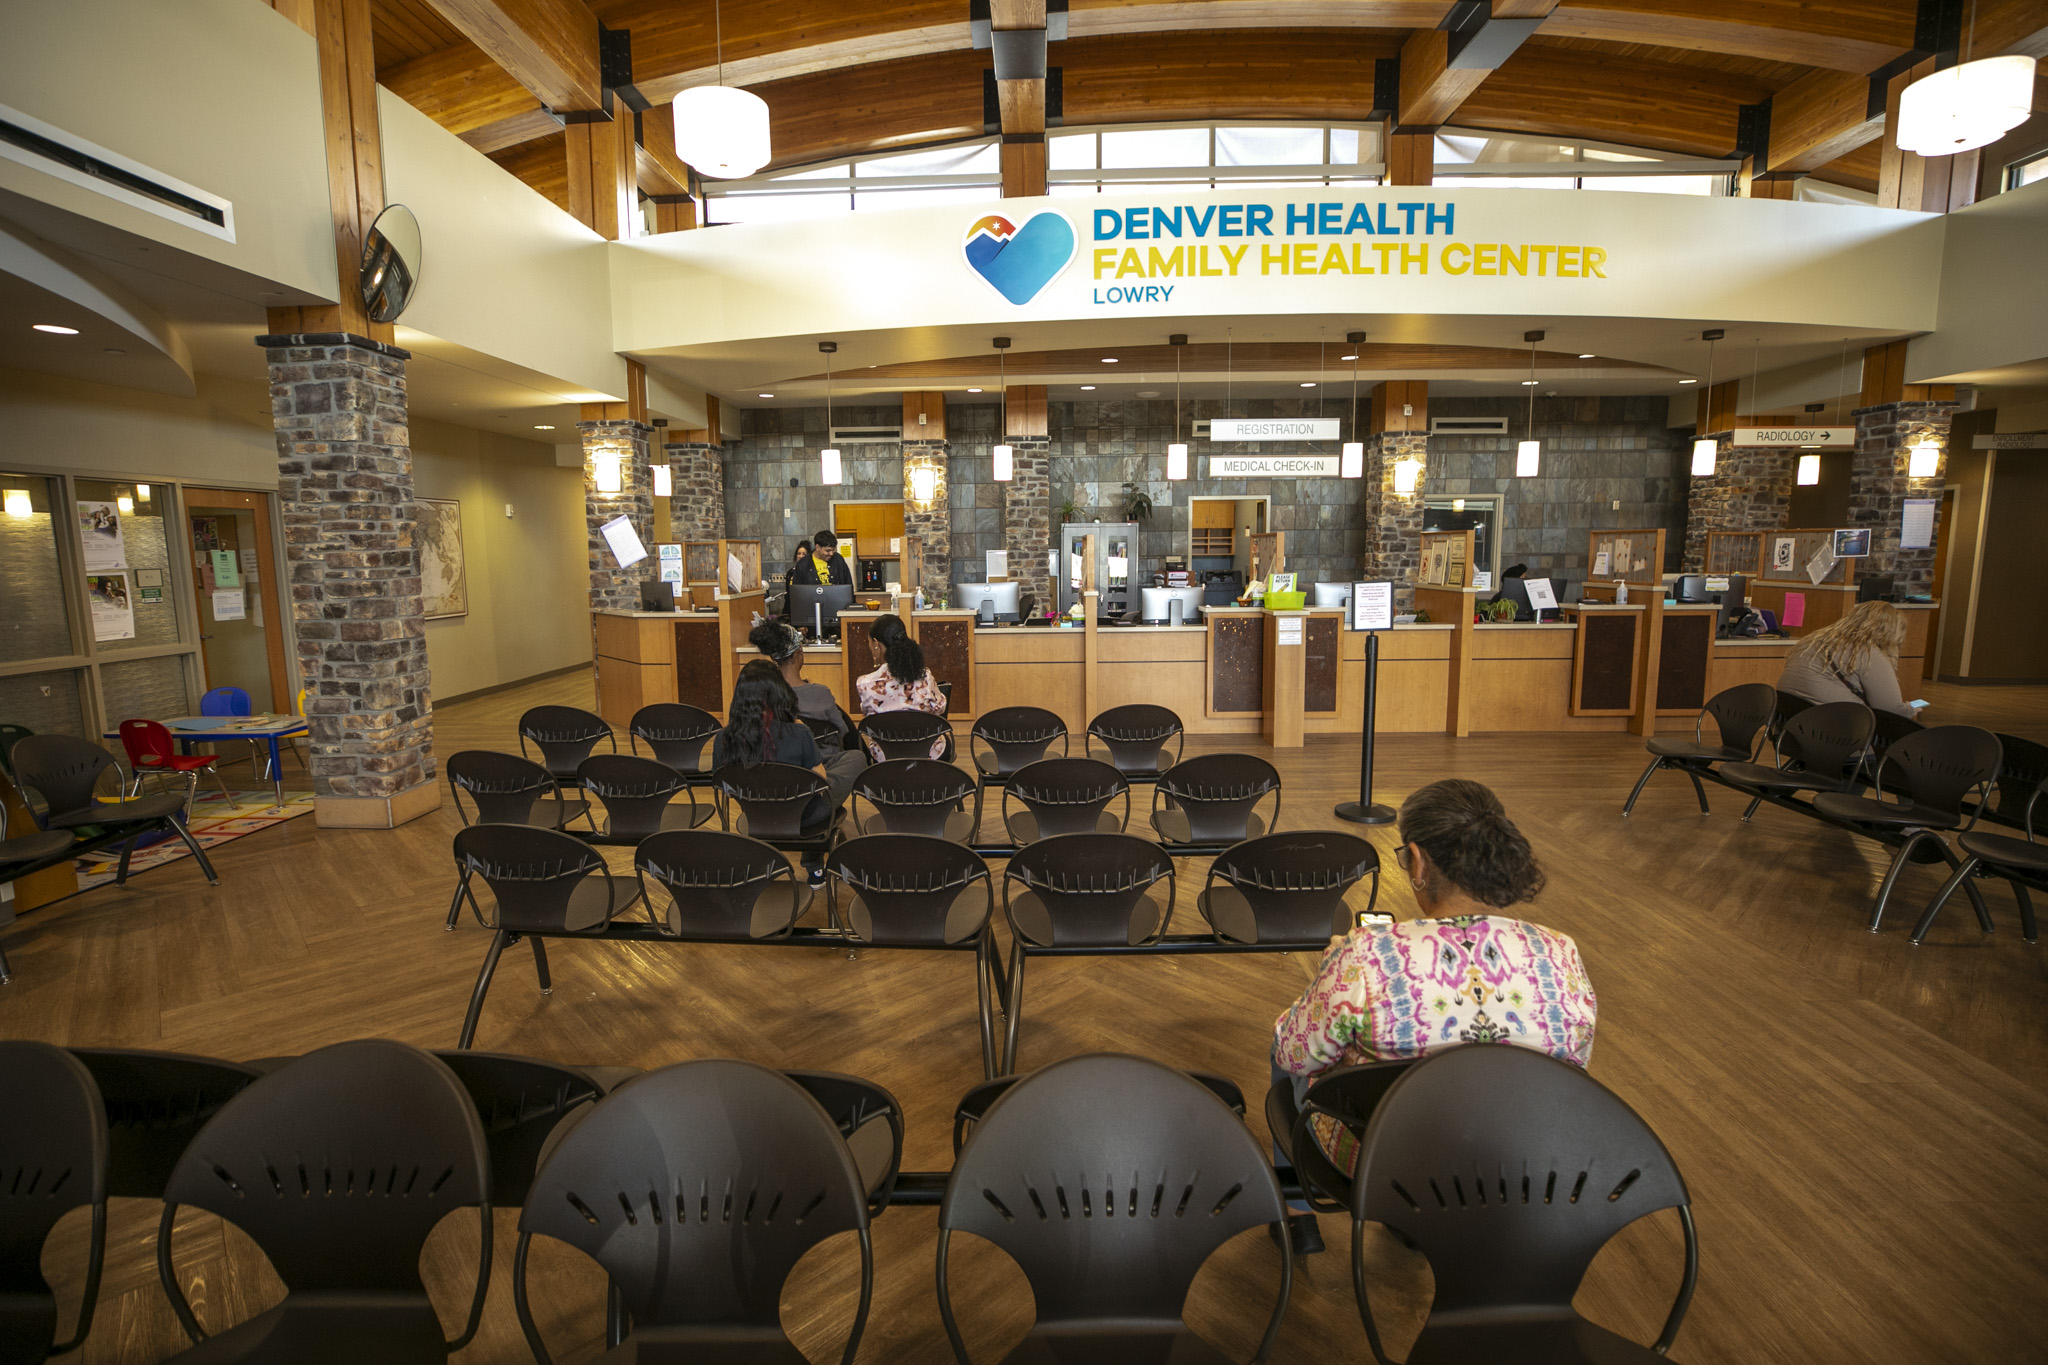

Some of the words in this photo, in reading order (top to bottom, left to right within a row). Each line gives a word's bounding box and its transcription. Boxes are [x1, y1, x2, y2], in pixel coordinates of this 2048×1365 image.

[1094, 204, 1274, 241] DENVER
[1286, 203, 1454, 235] HEALTH
[1094, 244, 1249, 280] FAMILY
[1261, 243, 1429, 275] HEALTH
[1440, 242, 1608, 278] CENTER
[1094, 285, 1174, 304] LOWRY
[1236, 423, 1314, 435] REGISTRATION
[1756, 431, 1816, 441] RADIOLOGY
[1992, 434, 2036, 442] ENROLLMENT
[1997, 441, 2035, 449] RADIOLOGY
[1224, 460, 1271, 472] MEDICAL
[1273, 460, 1325, 472] CHECK-IN
